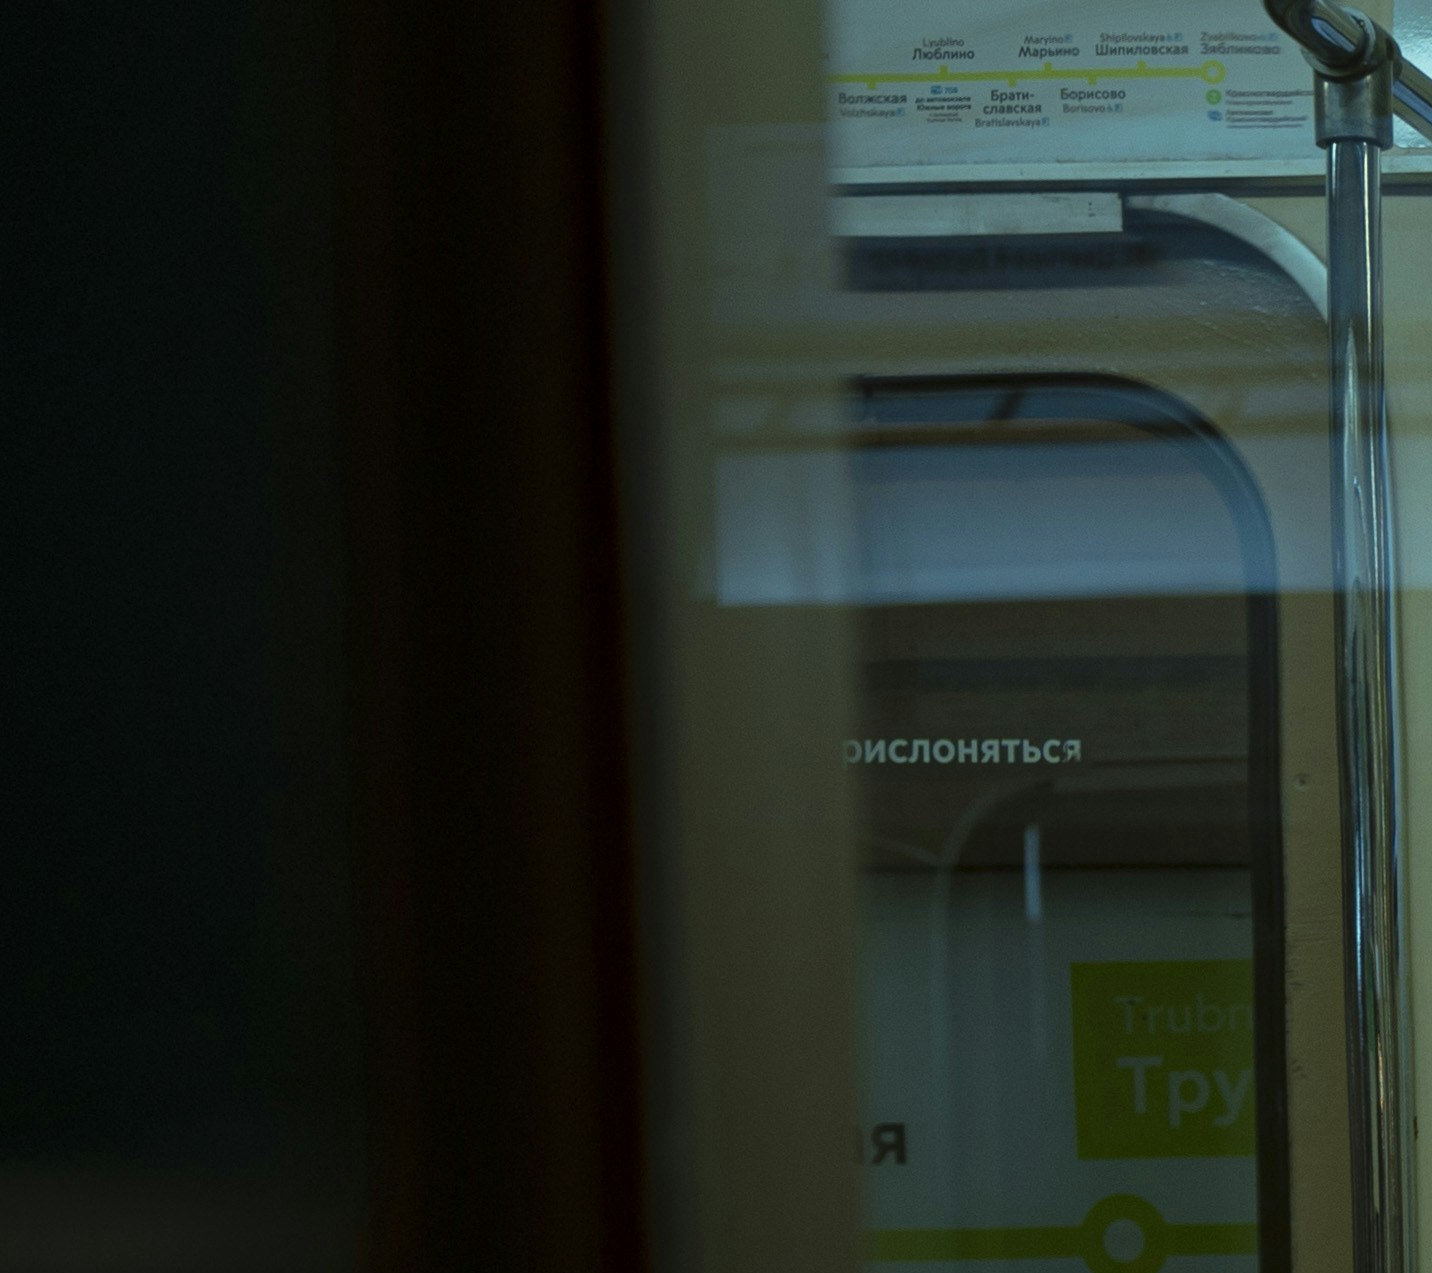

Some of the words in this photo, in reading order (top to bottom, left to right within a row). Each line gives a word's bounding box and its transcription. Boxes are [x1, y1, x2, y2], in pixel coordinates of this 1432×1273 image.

[912, 48, 975, 60] Люблино
[1018, 46, 1080, 60] Марьино
[1095, 44, 1188, 56] Шипиловская
[838, 92, 907, 105] Волжская
[990, 89, 1035, 103] Брати-
[1060, 88, 1126, 102] Борисово
[982, 104, 1042, 115] славская
